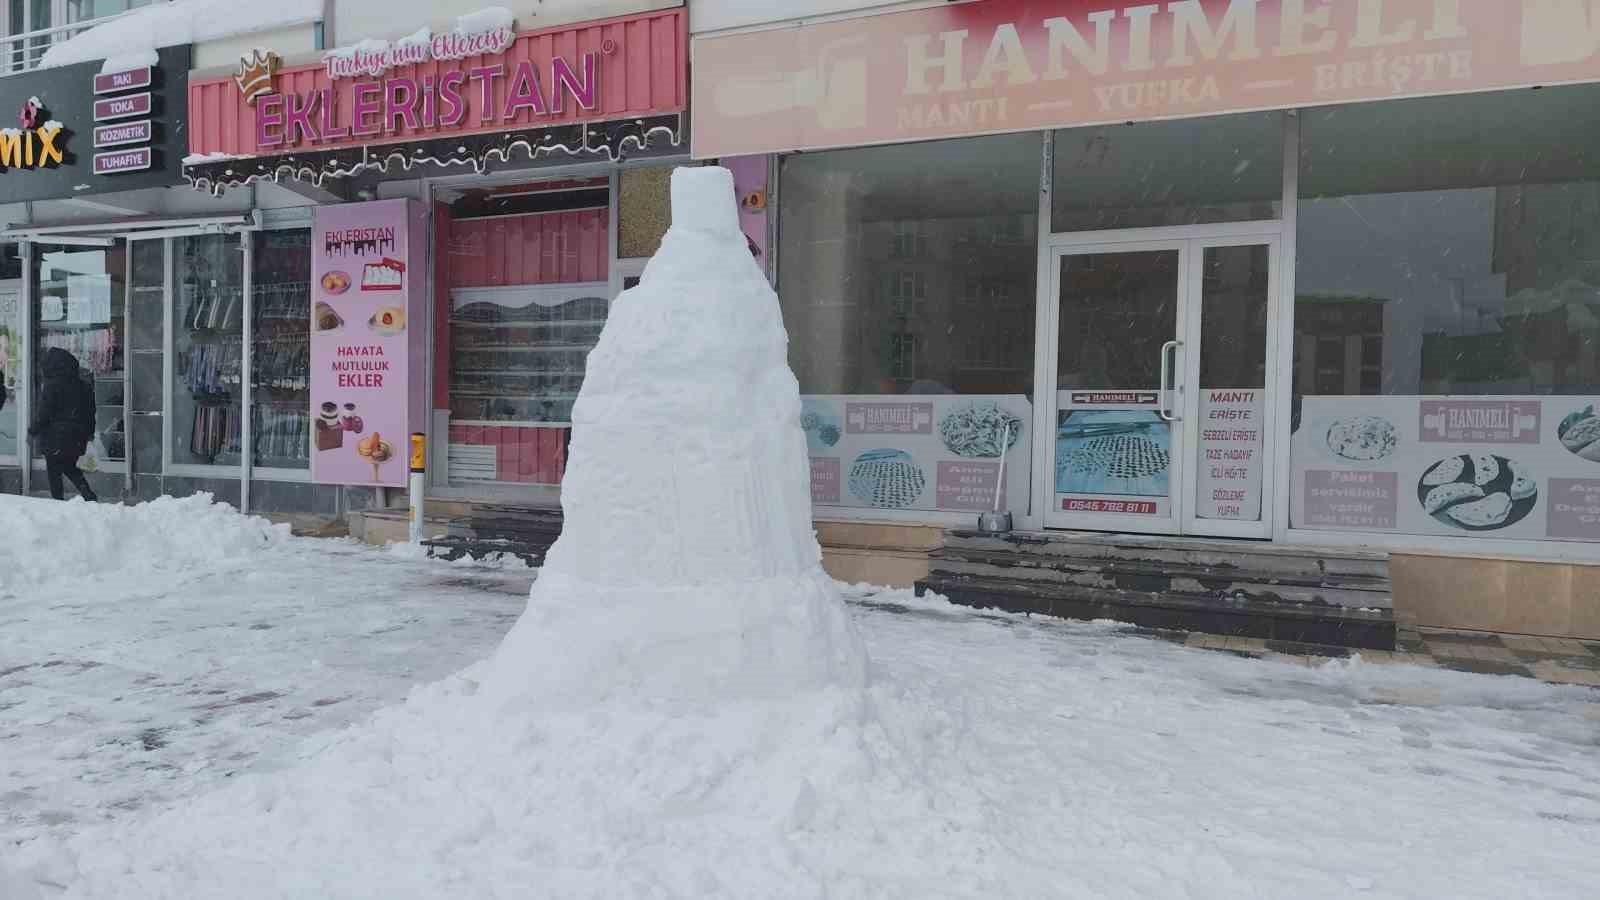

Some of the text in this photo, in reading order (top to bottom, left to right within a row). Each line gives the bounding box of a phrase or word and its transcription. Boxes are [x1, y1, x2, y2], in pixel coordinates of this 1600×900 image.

[112, 73, 132, 86] TAKI
[110, 100, 135, 113] TOKA
[896, 96, 1009, 130] MANTI
[1094, 75, 1221, 113] YUFKA
[337, 346, 384, 356] HAYATA
[332, 360, 390, 371] MUTLULUK
[339, 374, 383, 387] EKLER
[1209, 392, 1255, 403] MANTI
